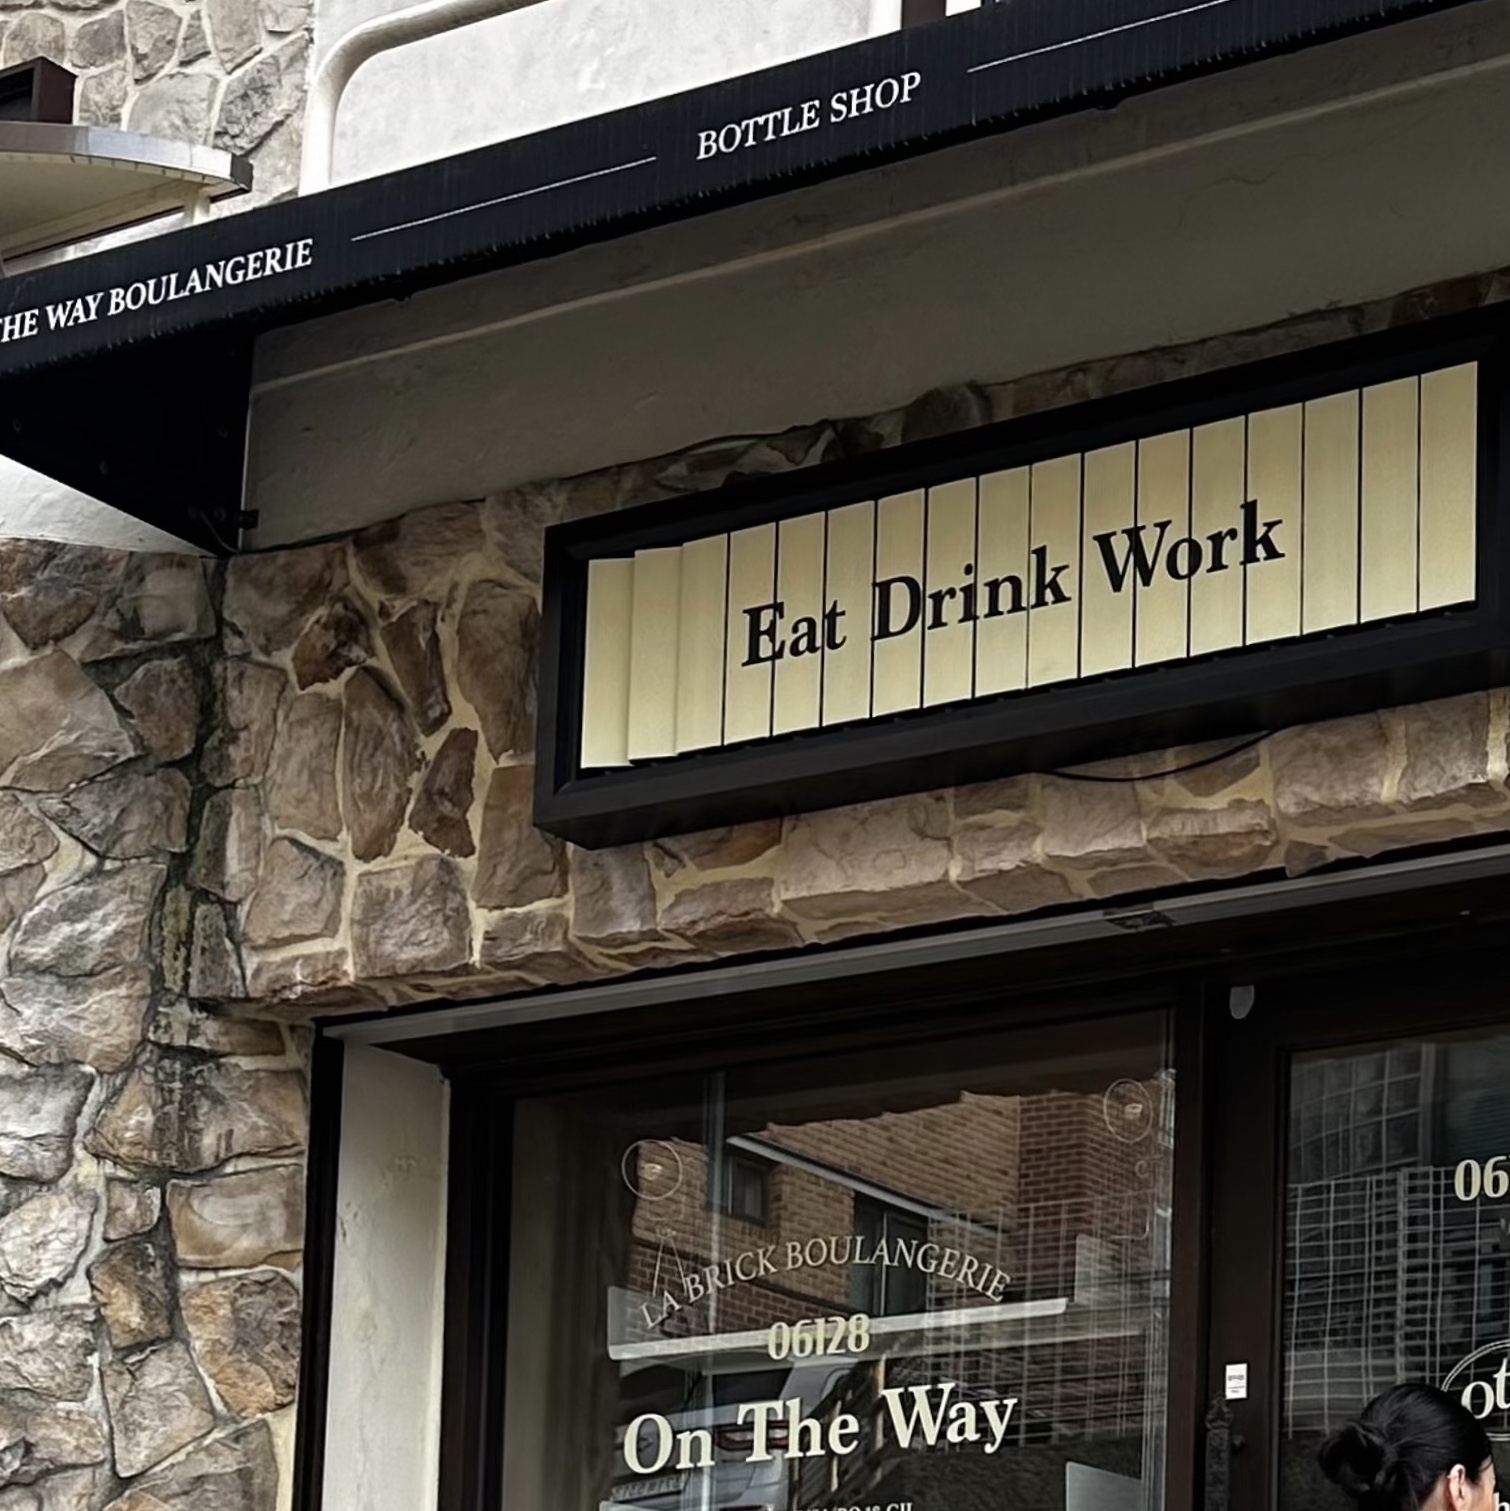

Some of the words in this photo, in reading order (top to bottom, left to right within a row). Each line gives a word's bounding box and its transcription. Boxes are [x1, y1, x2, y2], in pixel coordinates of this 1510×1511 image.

[696, 99, 820, 160] BOTTLE
[830, 71, 922, 123] SHOP
[46, 292, 104, 330] WAY
[107, 238, 314, 316] BOULANGERIE
[741, 603, 847, 667] Eat
[871, 545, 1072, 643] Drink
[1093, 499, 1286, 594] Work
[639, 1289, 680, 1329] LA
[685, 1243, 779, 1305] BRICK
[786, 1234, 1013, 1303] BOULANGERIE
[767, 1313, 870, 1360] 06128
[622, 1413, 715, 1475] On
[737, 1397, 860, 1464] The
[881, 1381, 1019, 1454] Way
